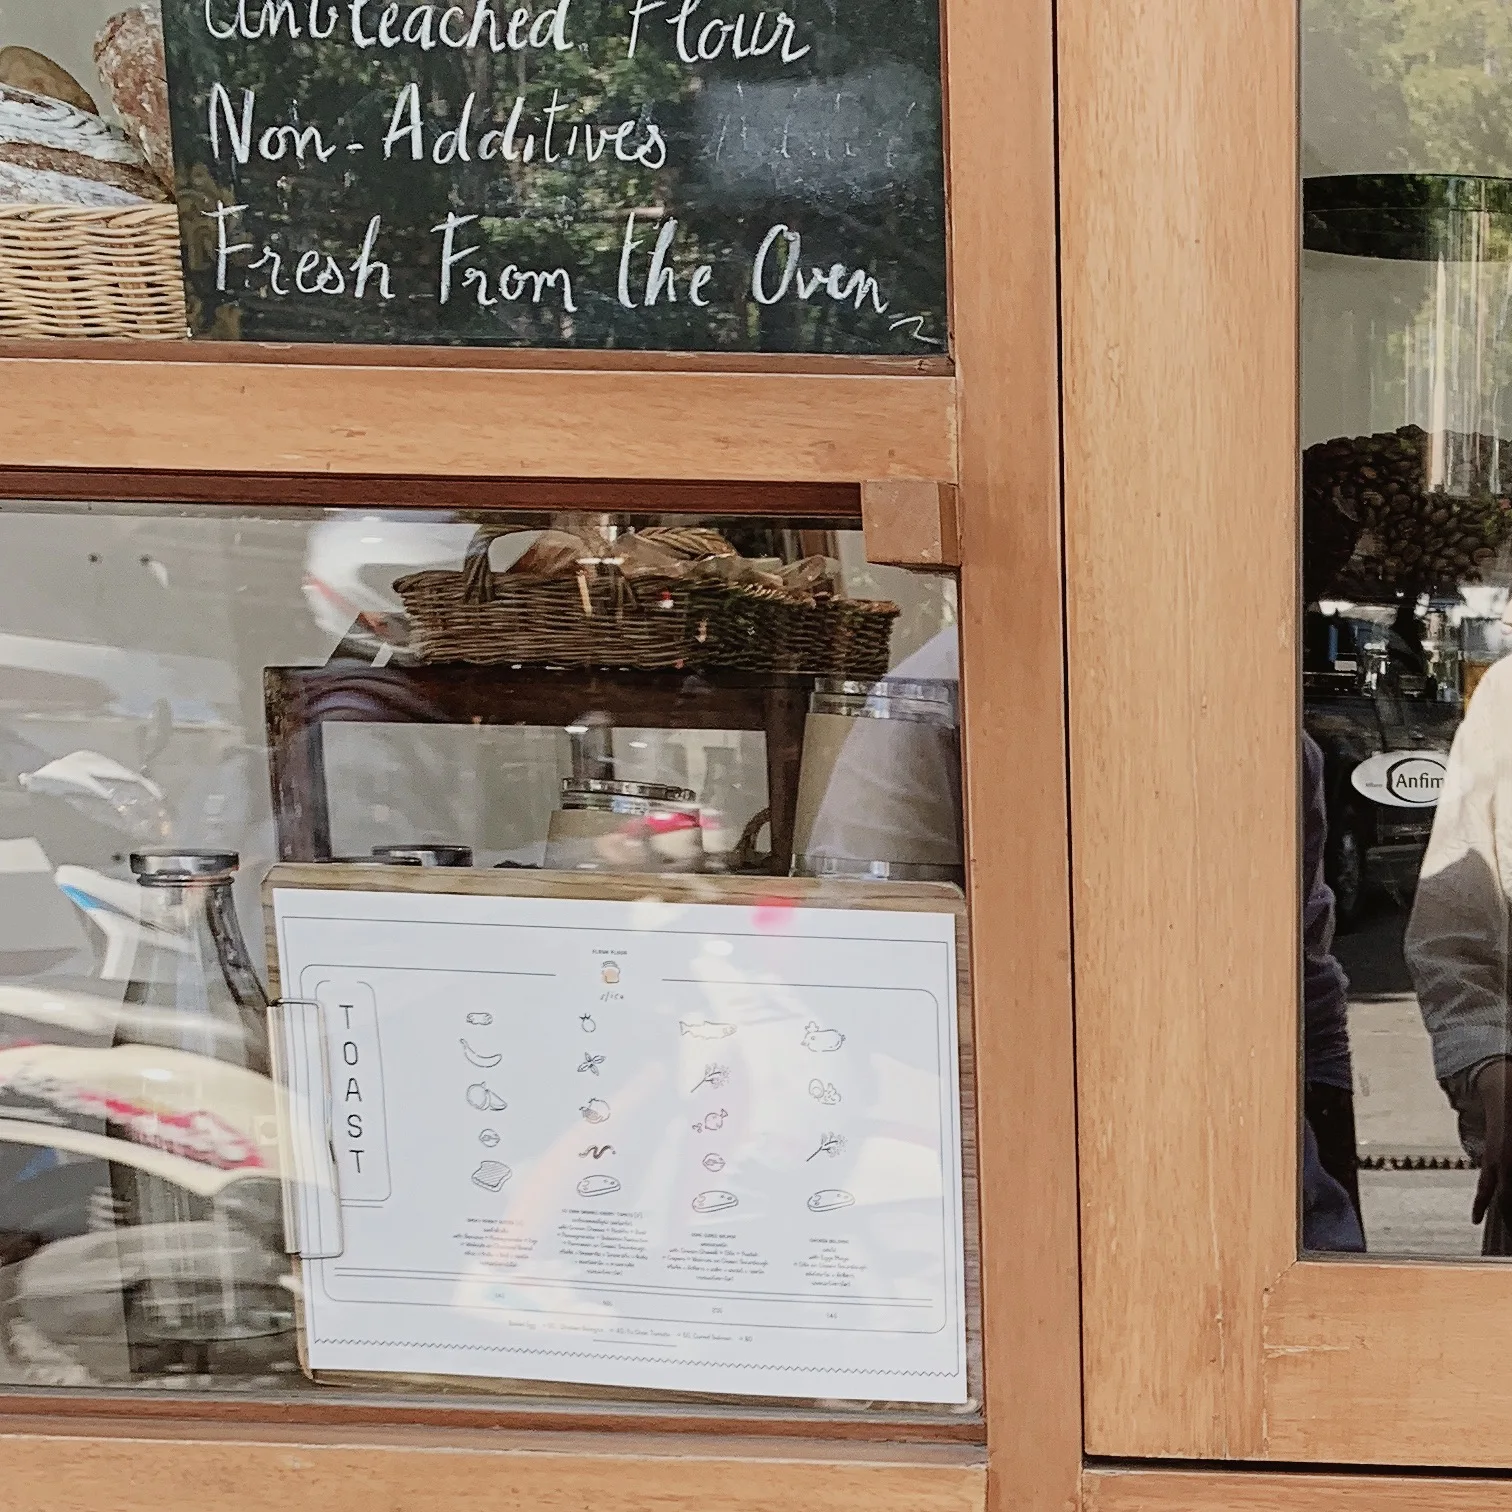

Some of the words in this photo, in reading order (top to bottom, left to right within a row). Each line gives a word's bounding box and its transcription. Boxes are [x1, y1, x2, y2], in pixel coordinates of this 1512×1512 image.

[200, 199, 397, 300] Fresh
[429, 210, 579, 313] From
[617, 210, 713, 309] the
[751, 223, 890, 313] Oven
[338, 1004, 365, 1174] TOAST
